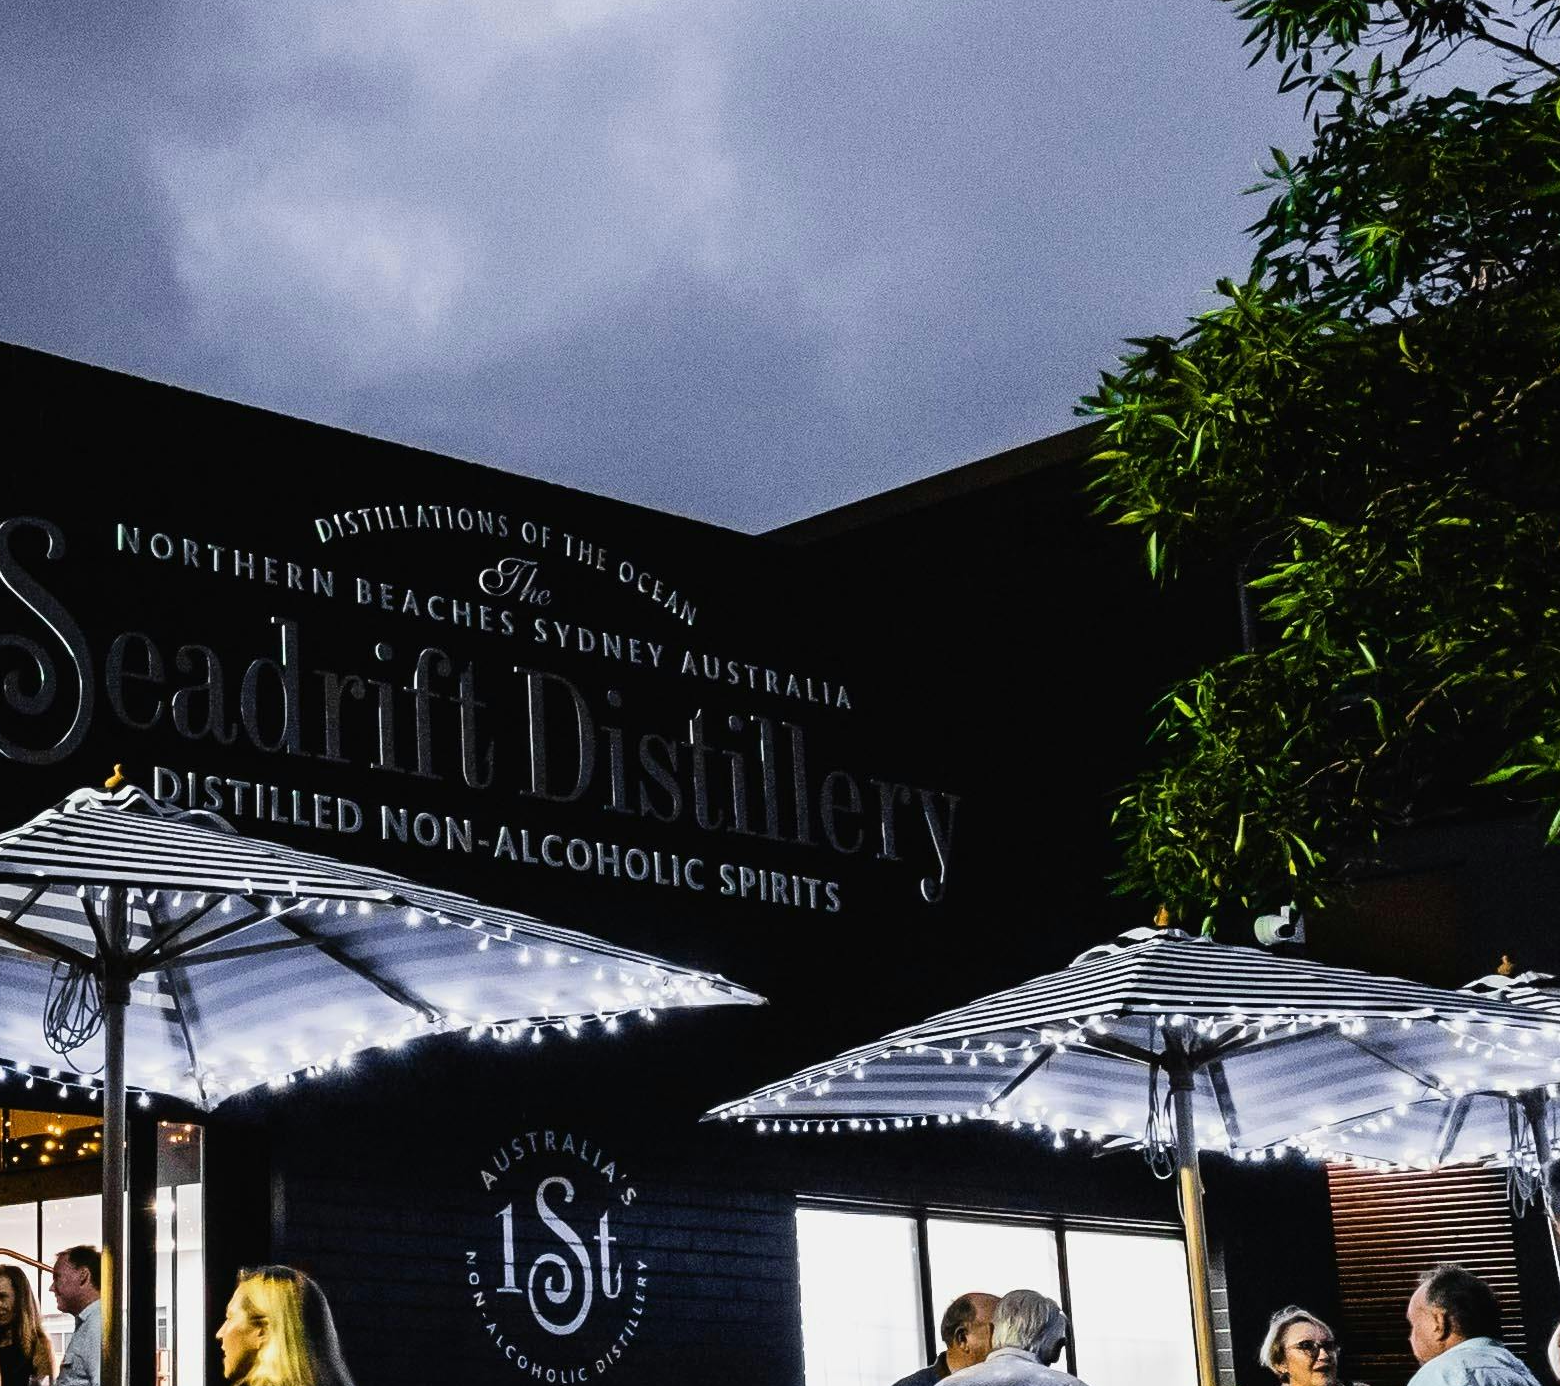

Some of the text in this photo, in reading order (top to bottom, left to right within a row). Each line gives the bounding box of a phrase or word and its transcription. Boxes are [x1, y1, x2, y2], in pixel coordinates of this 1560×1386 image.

[116, 522, 852, 710] NORTHERN BEACHES SYDNEY AUSTRALIA
[314, 505, 697, 626] DISTILLATIONS OF THE OCEAN
[478, 557, 553, 607] The
[153, 765, 841, 912] DISTILLED NON-ALCOHOLIC SPIRITS
[513, 665, 961, 903] Distillery
[480, 1130, 637, 1206] AUSTRALIA'S
[465, 1250, 649, 1384] NON-ALCOHOLIC DISTILLERY
